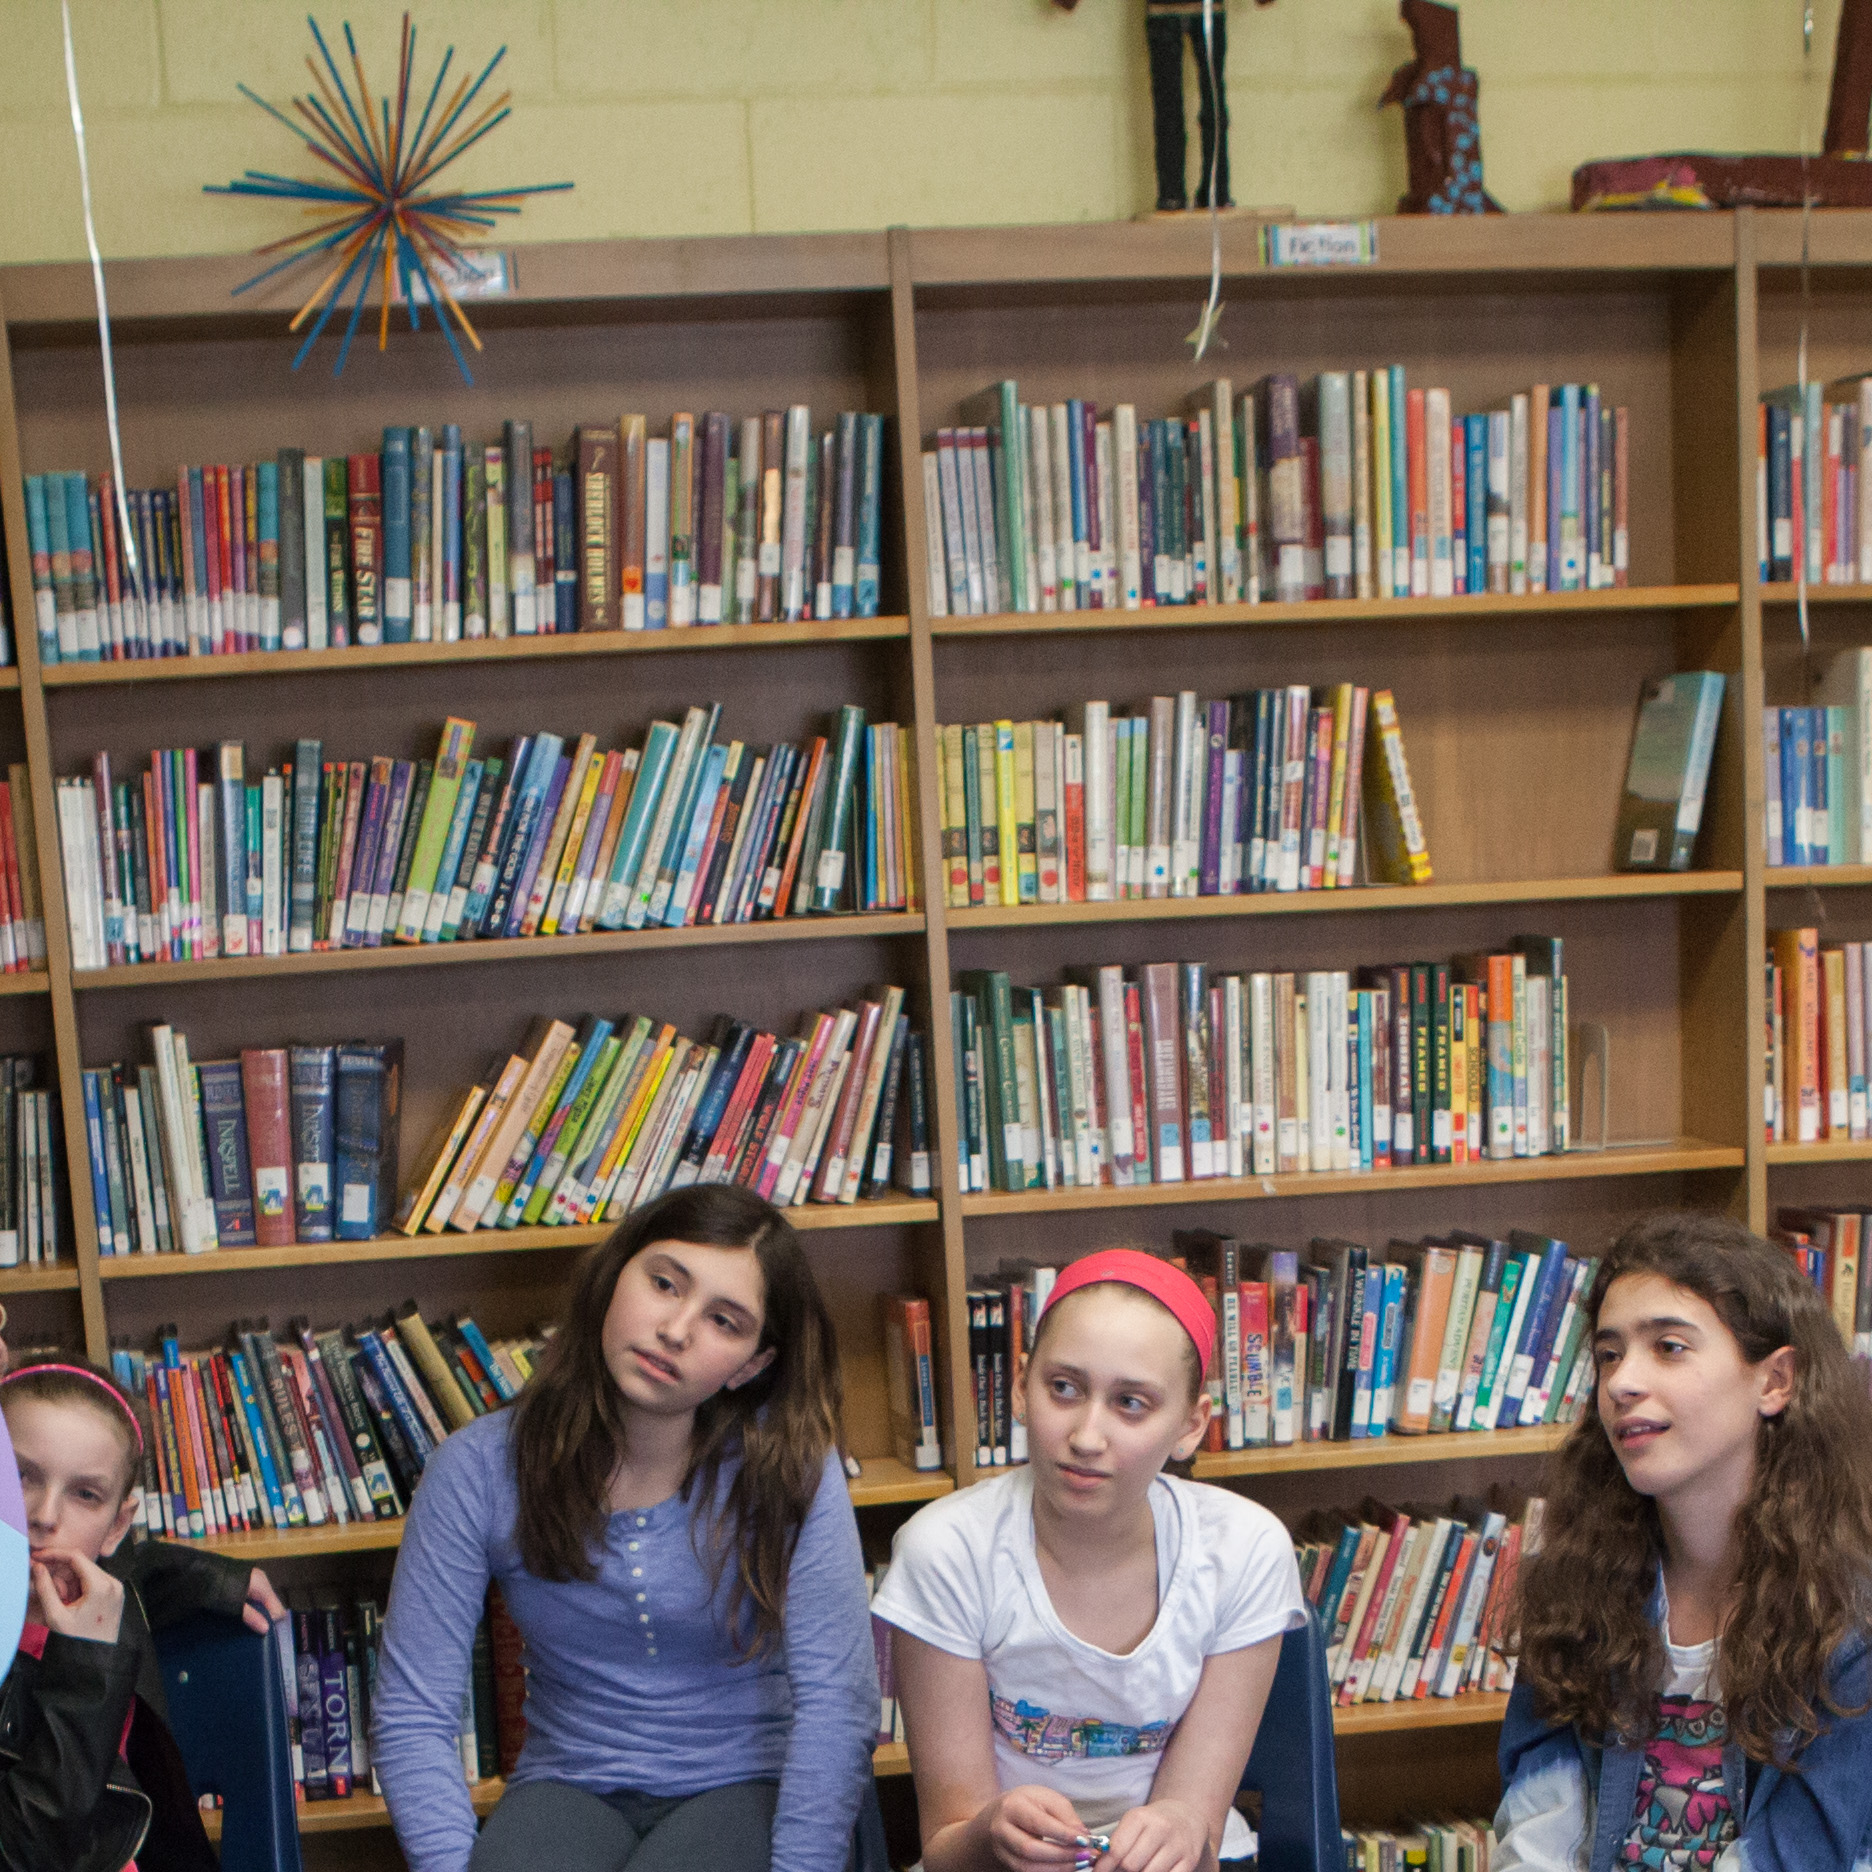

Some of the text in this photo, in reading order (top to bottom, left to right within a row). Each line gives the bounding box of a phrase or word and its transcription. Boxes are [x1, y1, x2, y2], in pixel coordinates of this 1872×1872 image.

[1289, 235, 1356, 258] Fiction
[584, 472, 605, 603] SHERLOCK HOLMES
[355, 527, 377, 618] FIRE STAR
[1417, 1026, 1427, 1093] FRAMED
[1437, 1024, 1447, 1091] FRAMED
[1469, 1046, 1479, 1104] SCHOOLED
[1514, 1035, 1525, 1066] Code
[1347, 1267, 1366, 1371] A WRINKLE IN TIME
[1245, 1333, 1265, 1398] SCUMBLE
[269, 1376, 297, 1436] RULES
[325, 1670, 348, 1773] TORN
